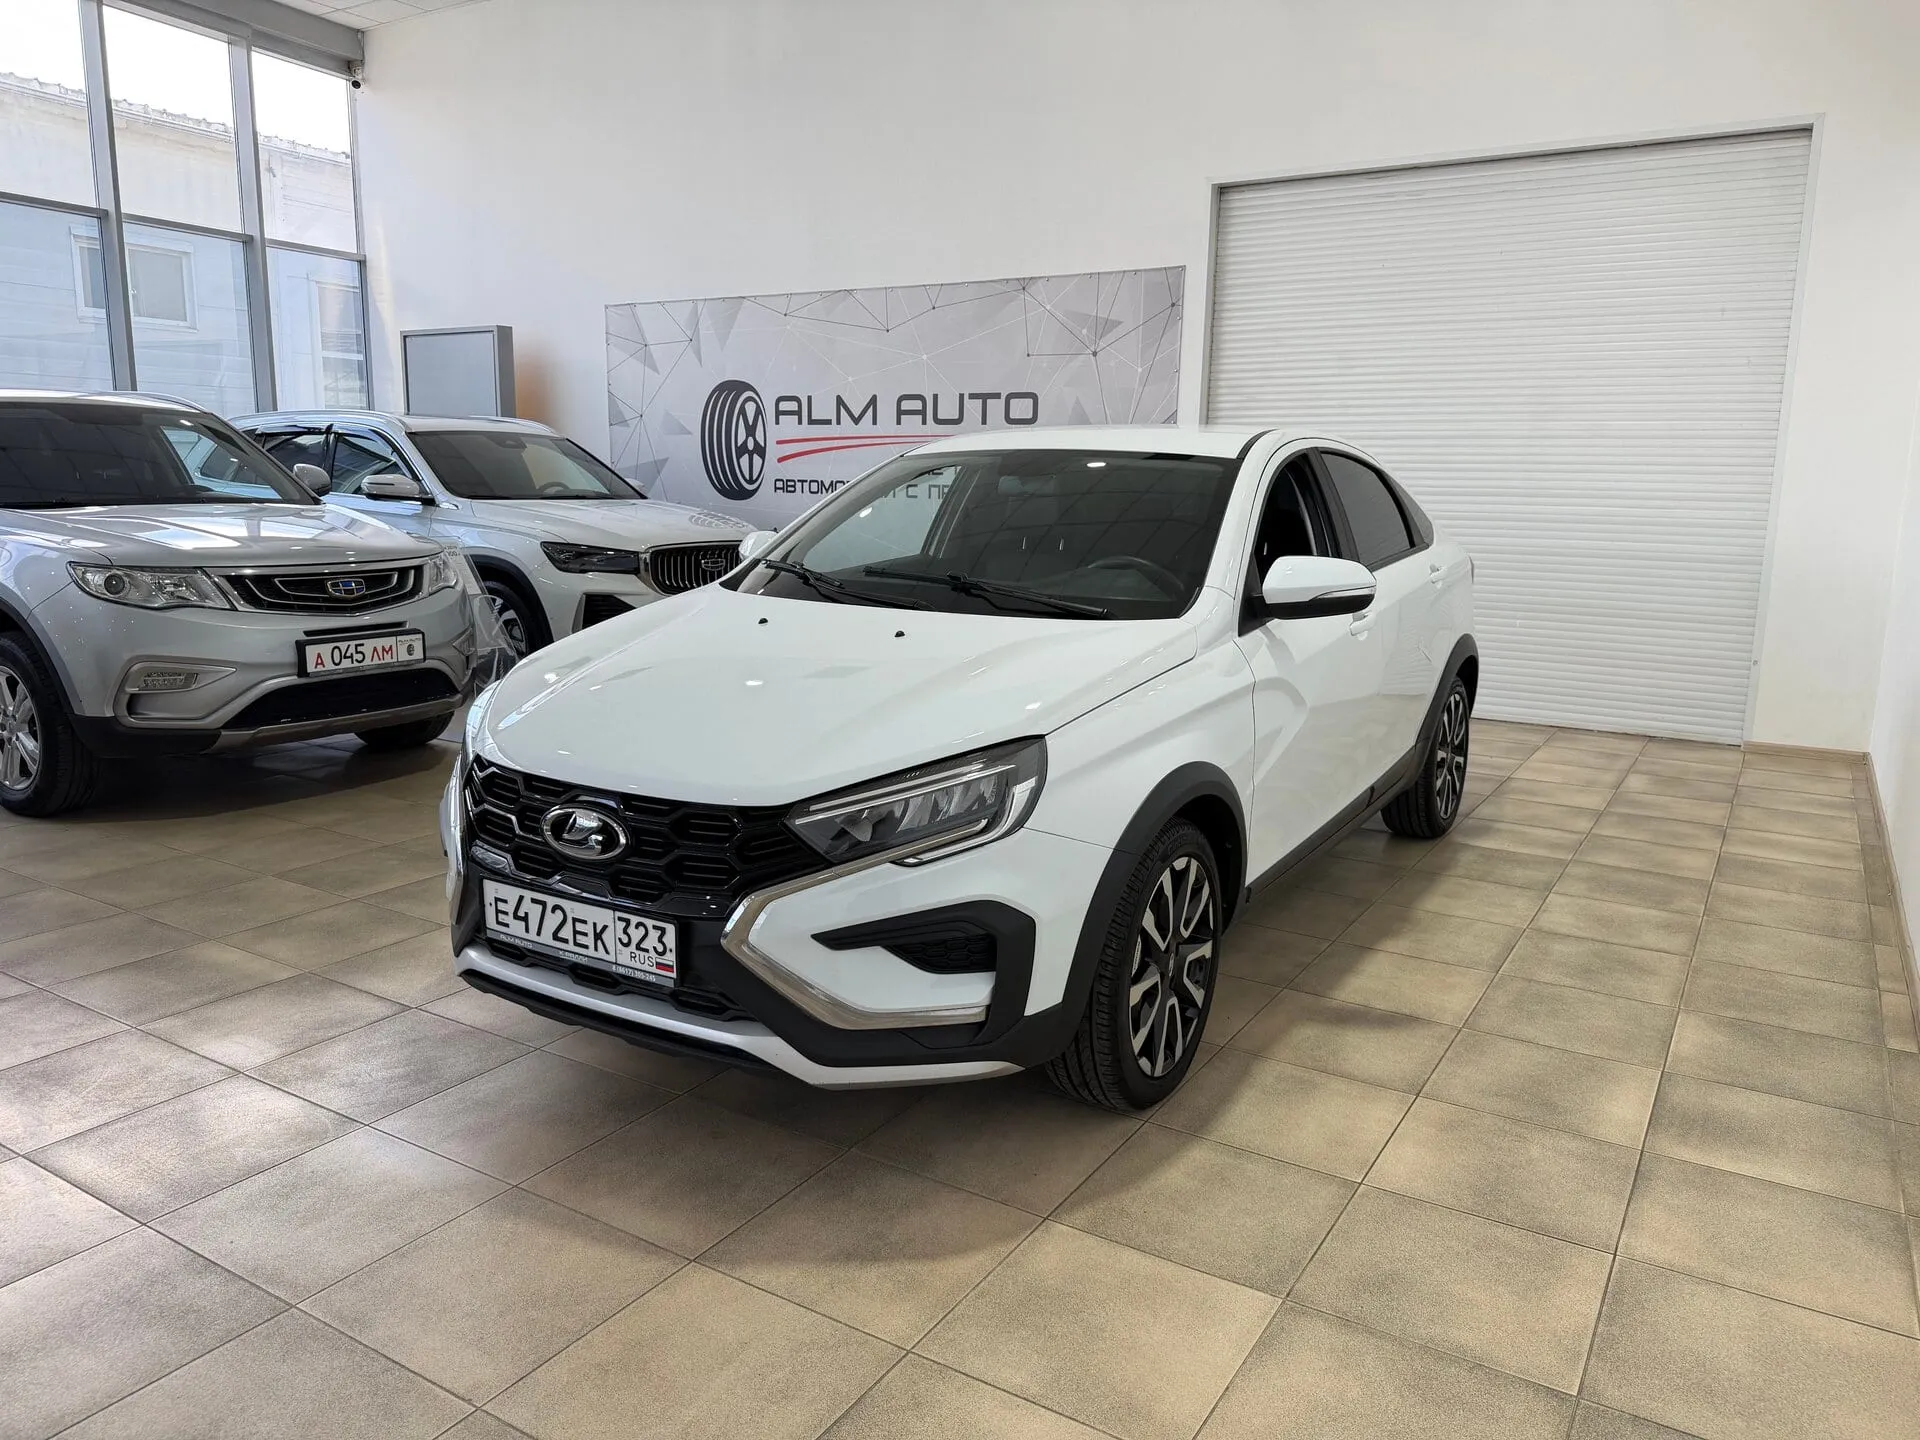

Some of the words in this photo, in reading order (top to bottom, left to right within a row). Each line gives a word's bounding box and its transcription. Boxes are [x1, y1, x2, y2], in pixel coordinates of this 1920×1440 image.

[774, 393, 878, 426] ALM
[895, 391, 1039, 426] AUTO
[330, 643, 366, 667] 045
[370, 645, 394, 663] ЛМ
[494, 895, 611, 956] Е472ЕК
[617, 916, 668, 957] 323
[629, 951, 655, 968] RUS
